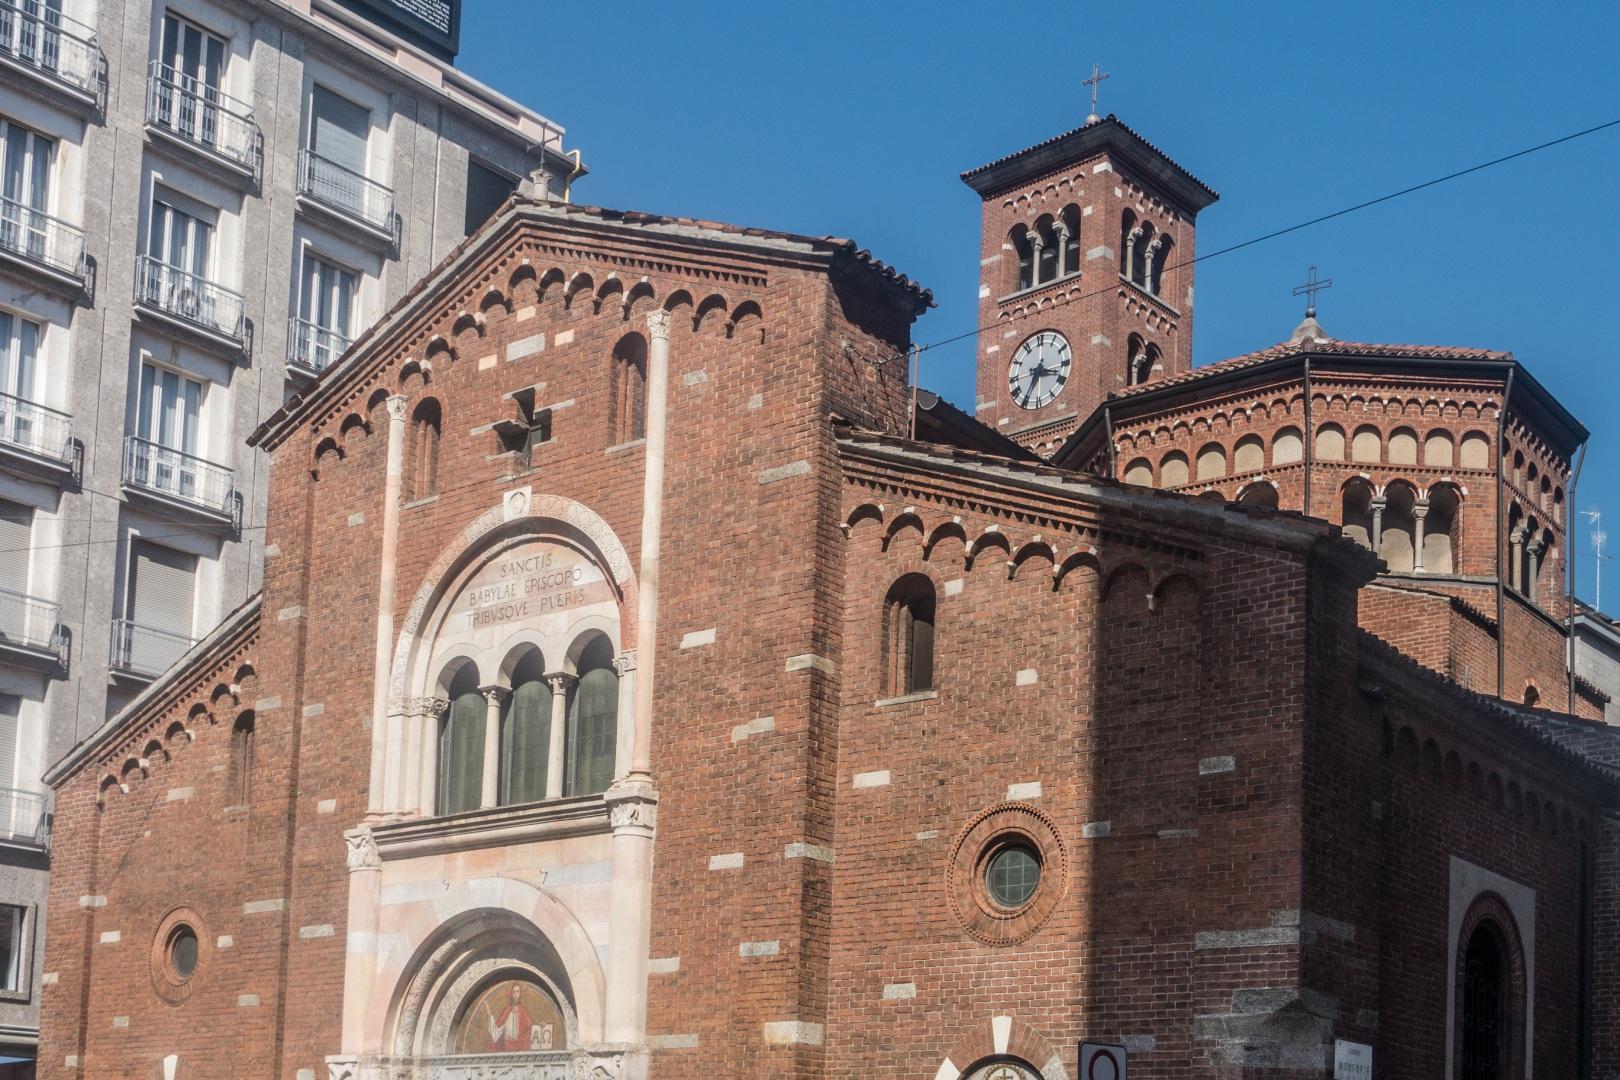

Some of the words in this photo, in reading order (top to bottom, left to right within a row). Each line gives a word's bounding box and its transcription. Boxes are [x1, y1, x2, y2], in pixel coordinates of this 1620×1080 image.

[500, 553, 553, 577] SANCTIS
[469, 583, 517, 606] BABYLAE
[524, 568, 582, 593] EPISCOPO
[540, 588, 585, 612] PVERIS
